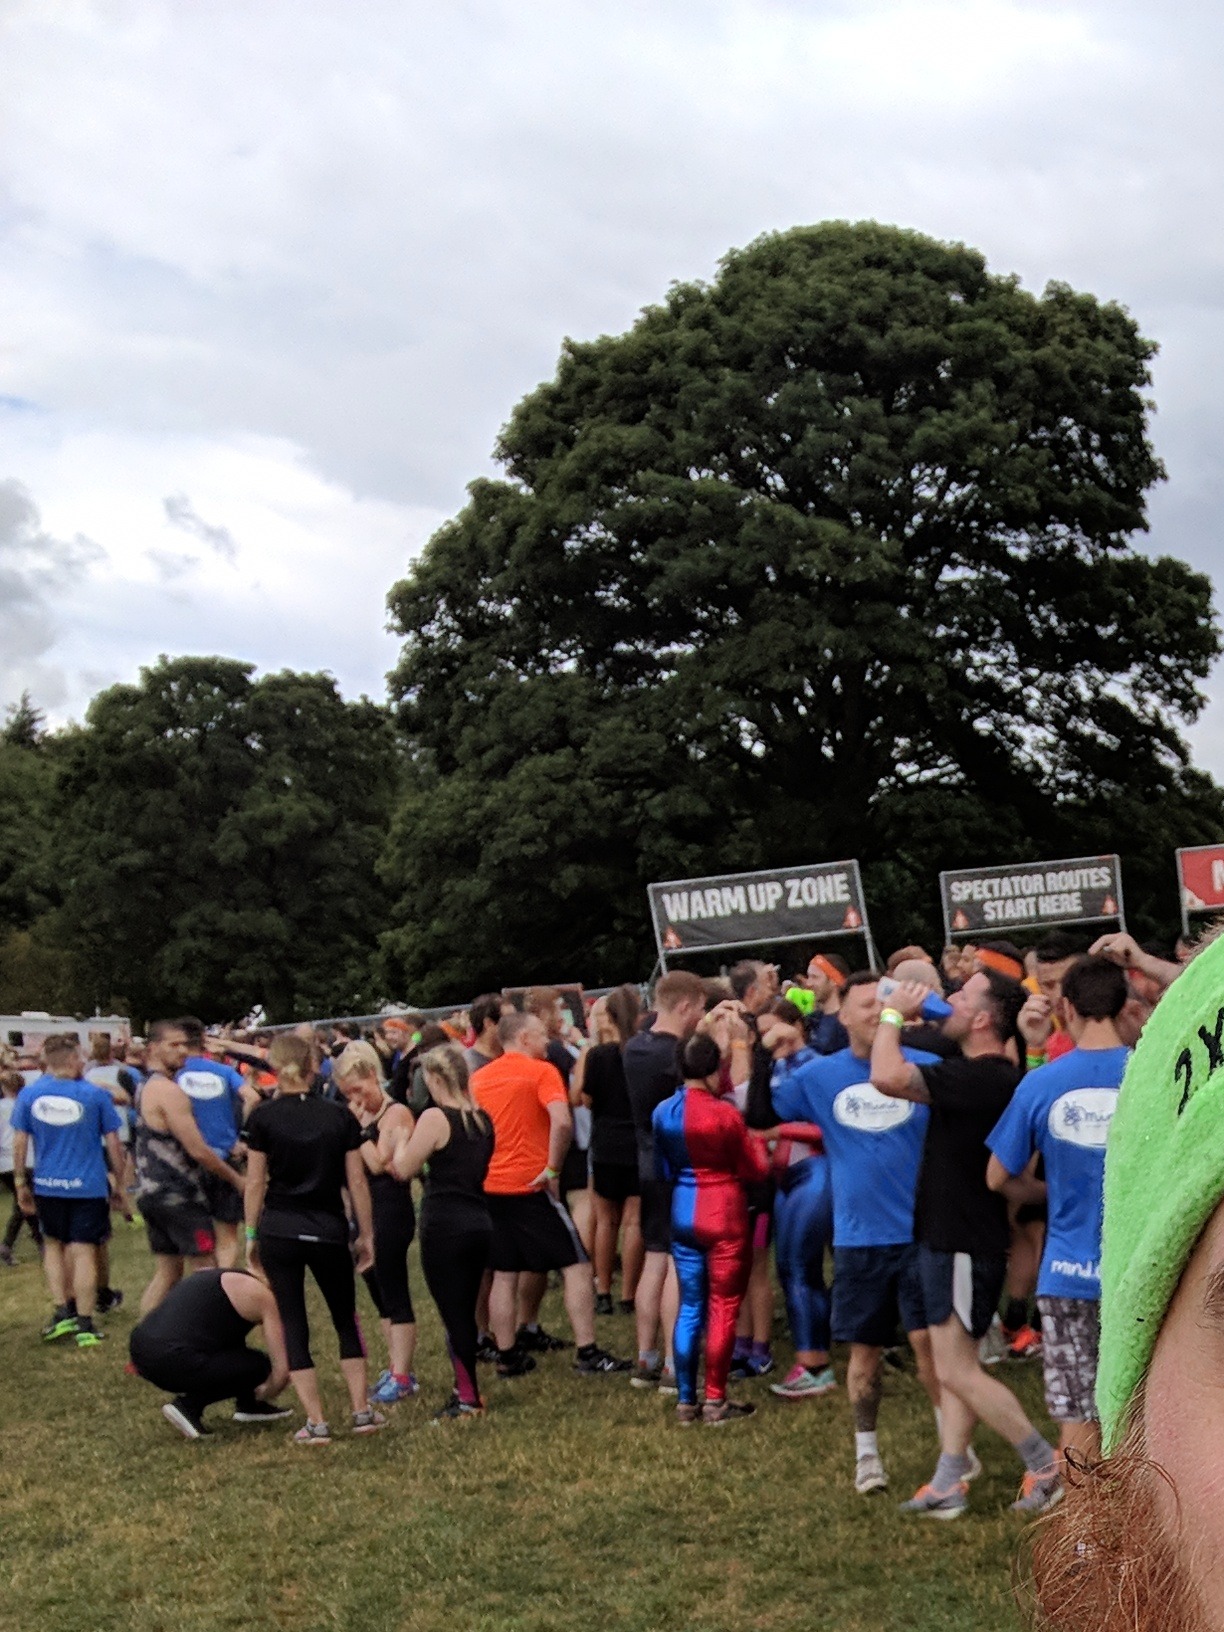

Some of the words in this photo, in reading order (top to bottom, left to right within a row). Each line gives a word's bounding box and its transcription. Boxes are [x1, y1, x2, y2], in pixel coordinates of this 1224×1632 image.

[662, 884, 748, 922] WARM
[749, 881, 783, 912] UP
[785, 873, 851, 908] ZONE
[950, 873, 1045, 902] SPECTATOR
[1046, 866, 1112, 893] ROUTES
[983, 899, 1037, 921] START
[1038, 892, 1083, 916] HERE
